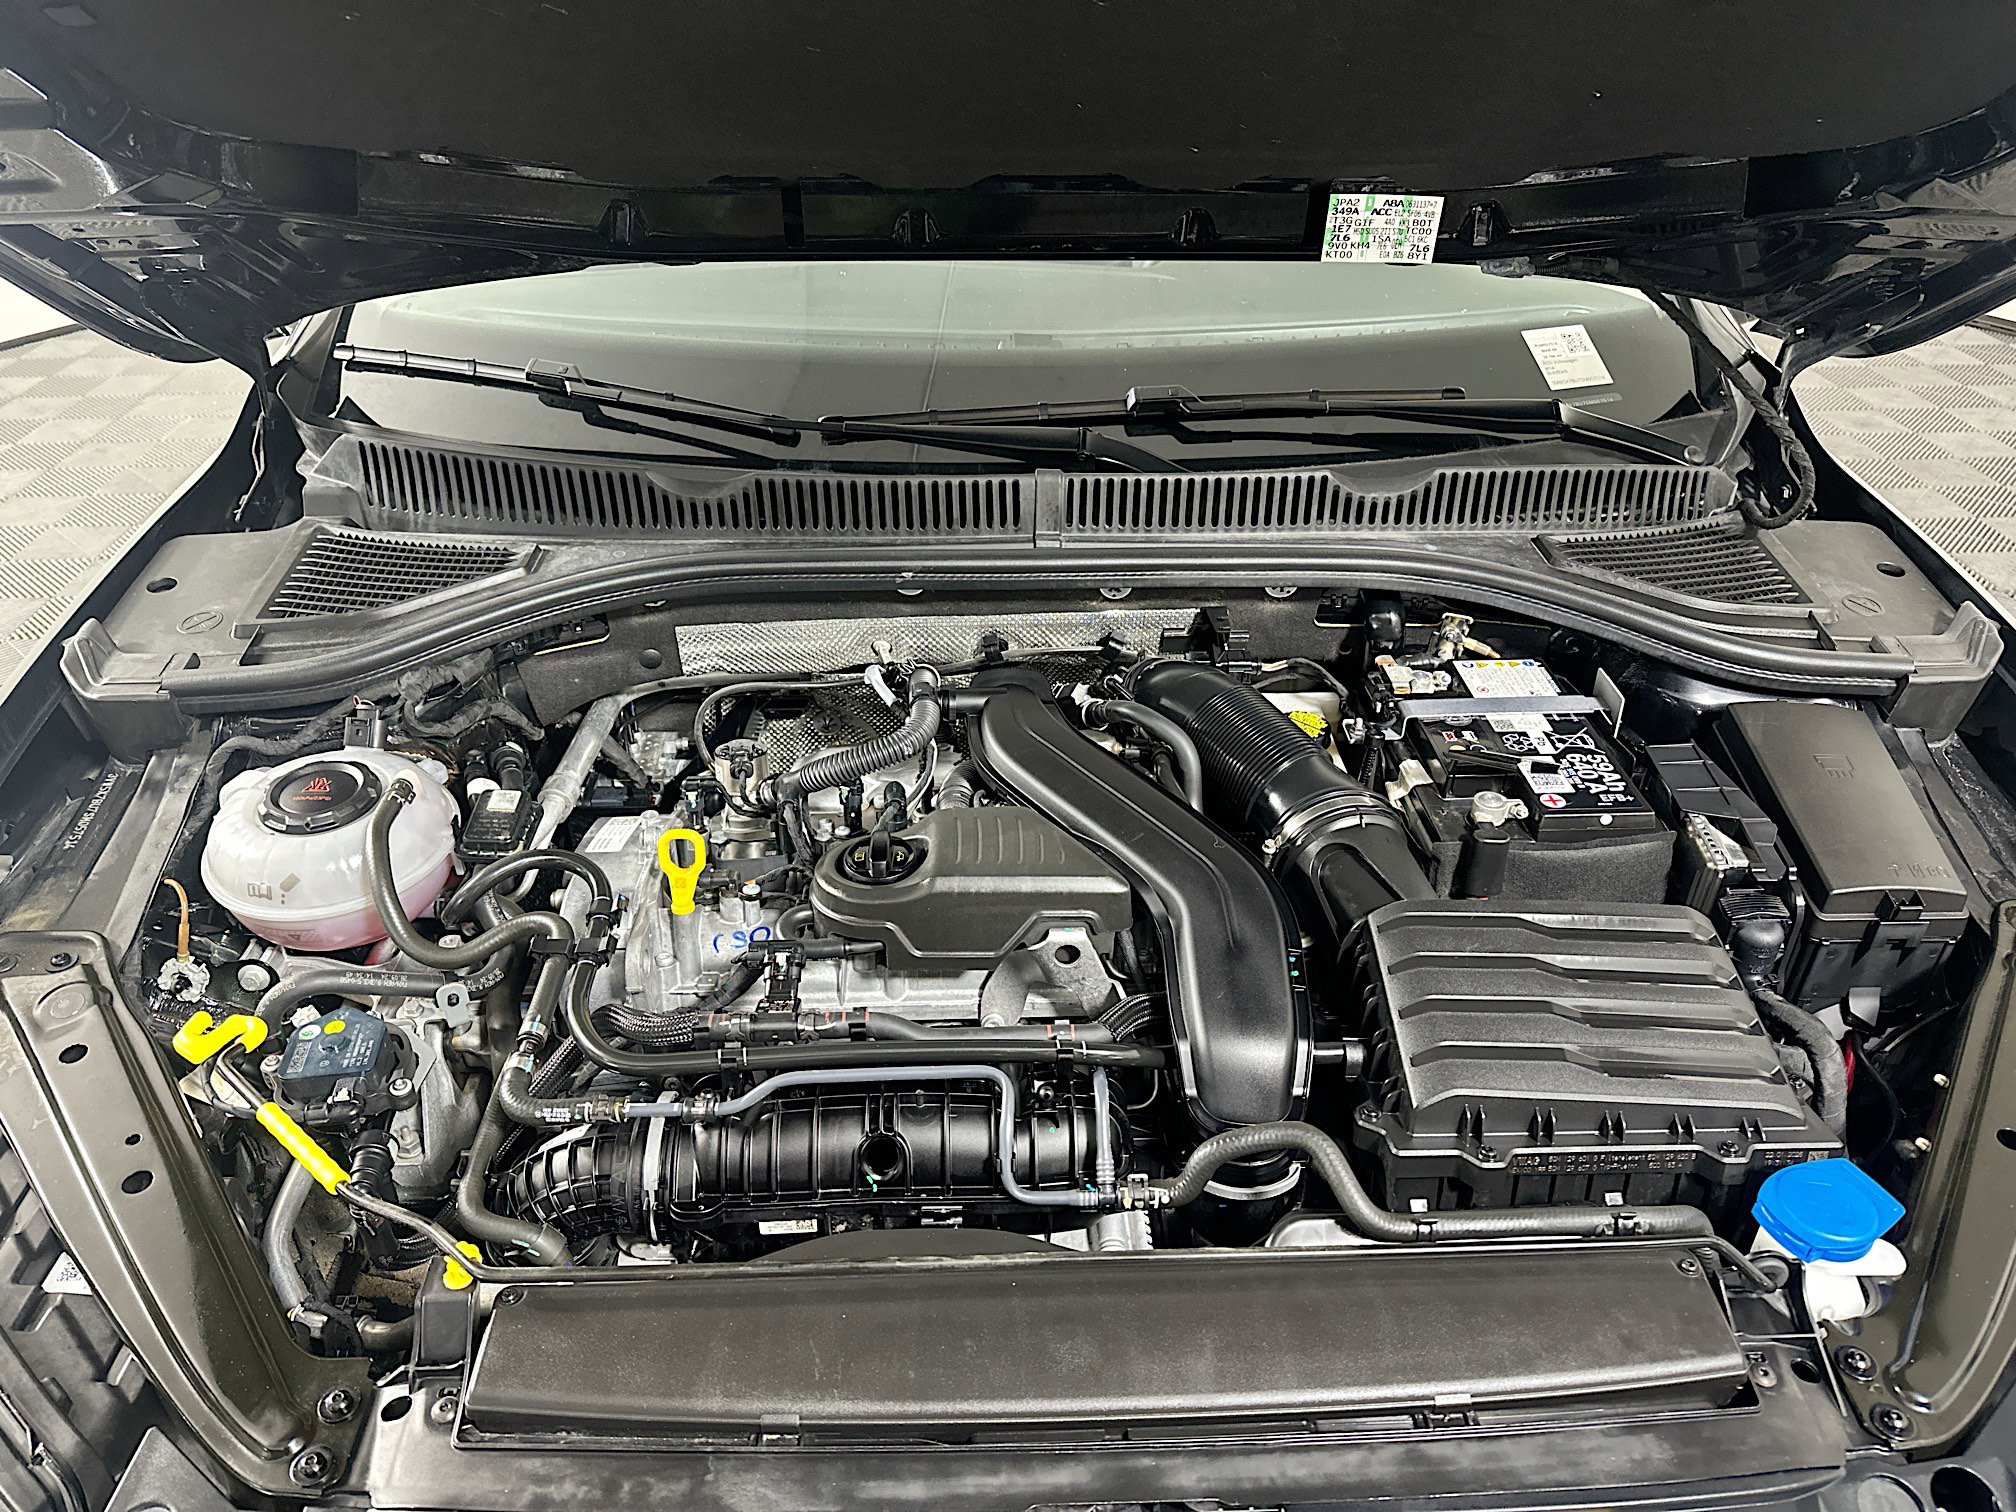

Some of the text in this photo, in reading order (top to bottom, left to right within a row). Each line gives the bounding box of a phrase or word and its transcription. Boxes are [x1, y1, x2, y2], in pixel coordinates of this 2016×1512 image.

[1332, 198, 1360, 206] JPA2
[1332, 207, 1360, 216] 349A
[1371, 208, 1393, 216] ACC
[1332, 225, 1352, 233] 1E7
[1330, 233, 1351, 242] 7L6
[1327, 242, 1348, 250] 9V0
[1410, 244, 1430, 253] 7L6
[1326, 250, 1353, 259] KT00
[1566, 753, 1599, 780] 640
[1584, 782, 1608, 794] A
[1587, 754, 1627, 792] 59Ah
